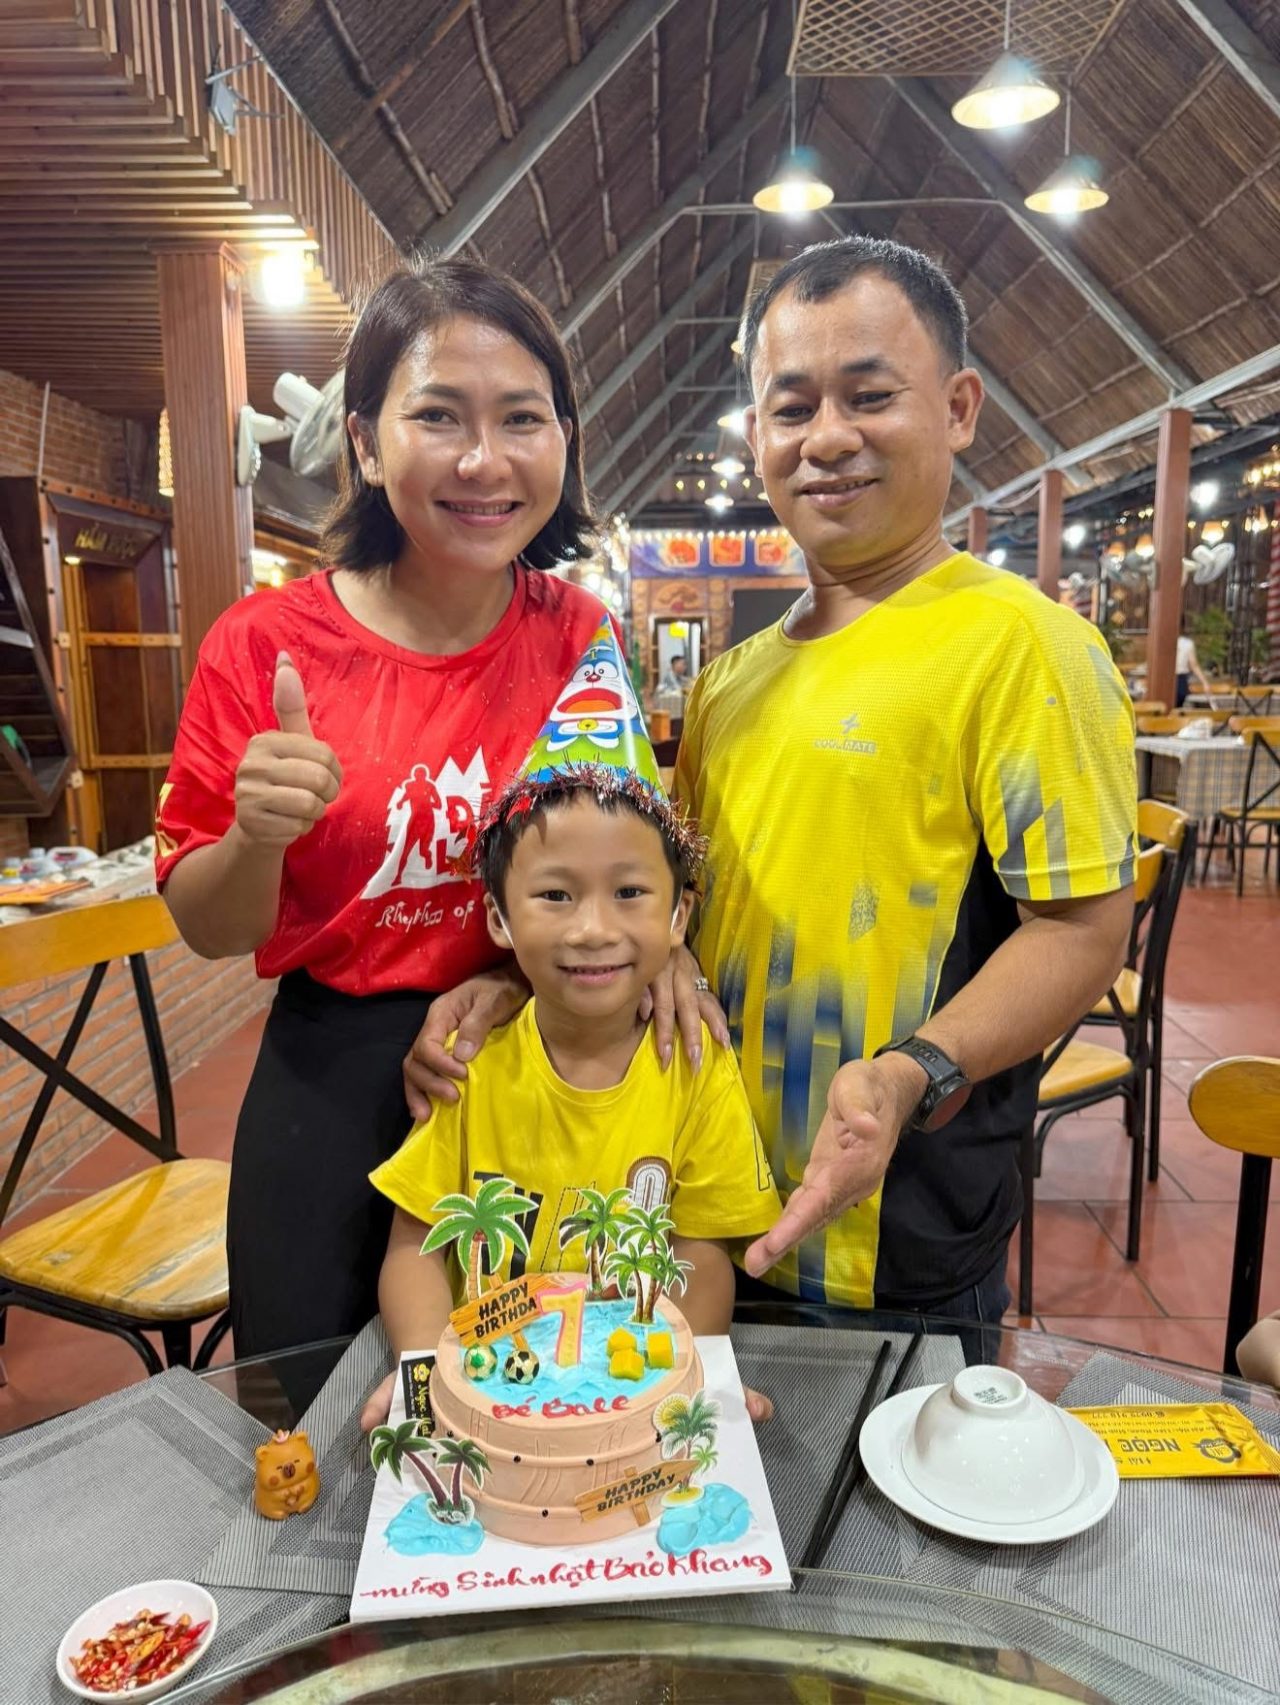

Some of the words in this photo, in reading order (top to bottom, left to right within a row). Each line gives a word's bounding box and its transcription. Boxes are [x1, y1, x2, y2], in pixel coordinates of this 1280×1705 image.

[453, 900, 475, 929] of
[474, 1297, 537, 1338] BIRTHDA
[478, 1281, 529, 1321] HAPPY
[1117, 1435, 1182, 1453] NGỌC
[596, 1473, 676, 1512] BIRTHDAY
[604, 1467, 662, 1499] HAPPY
